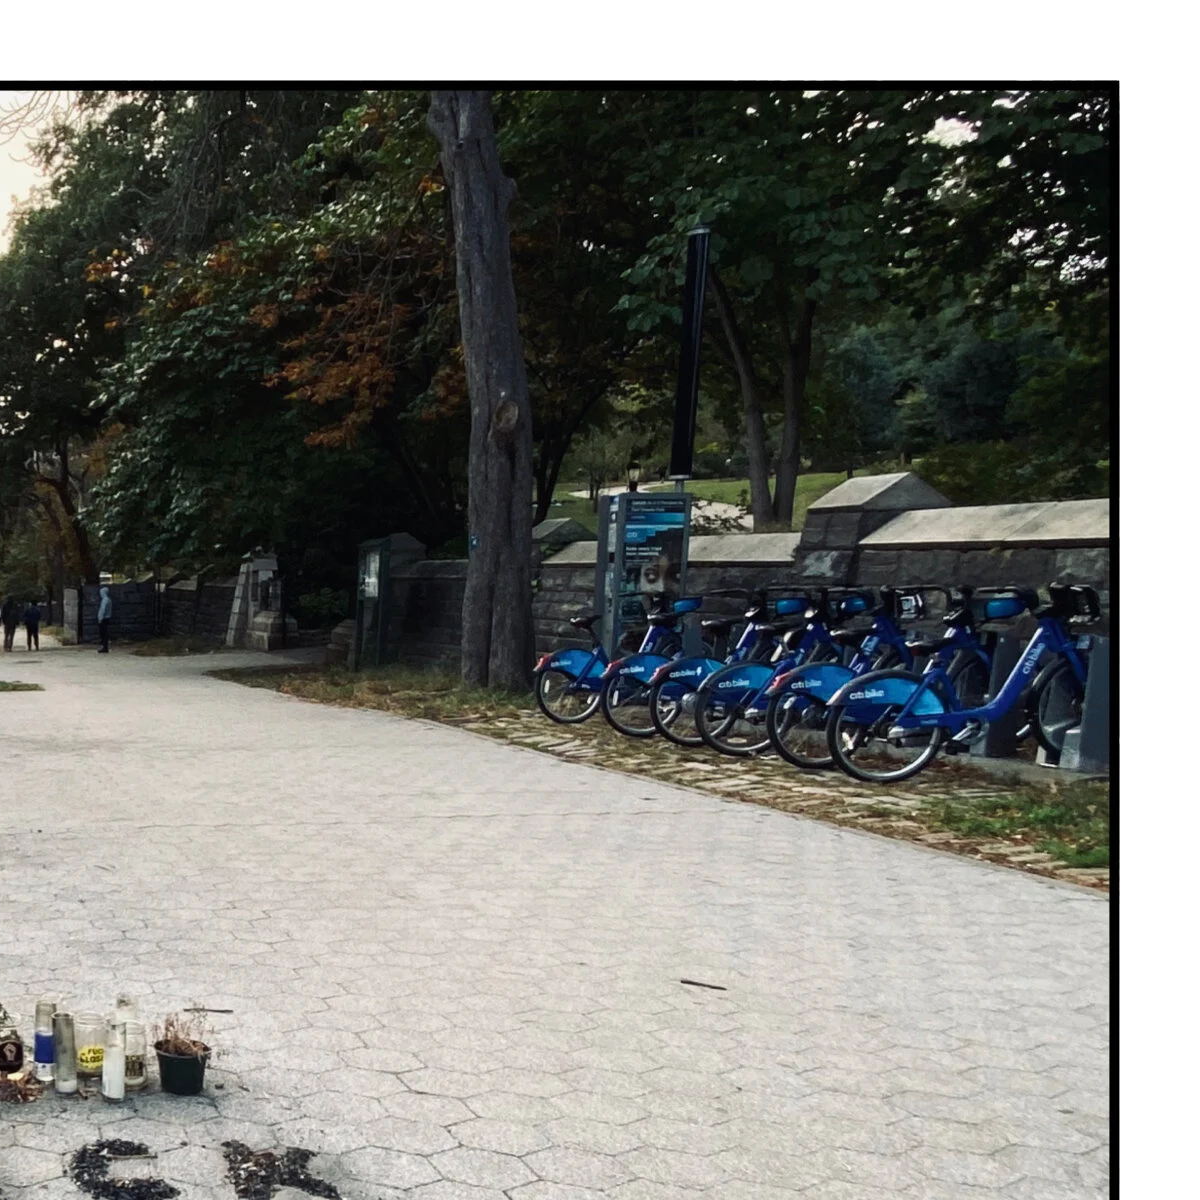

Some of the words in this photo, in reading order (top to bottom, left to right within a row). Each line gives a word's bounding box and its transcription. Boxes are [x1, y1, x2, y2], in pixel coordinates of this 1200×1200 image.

[804, 678, 822, 688] bike
[850, 691, 864, 700] citi
[864, 688, 885, 698] bike
